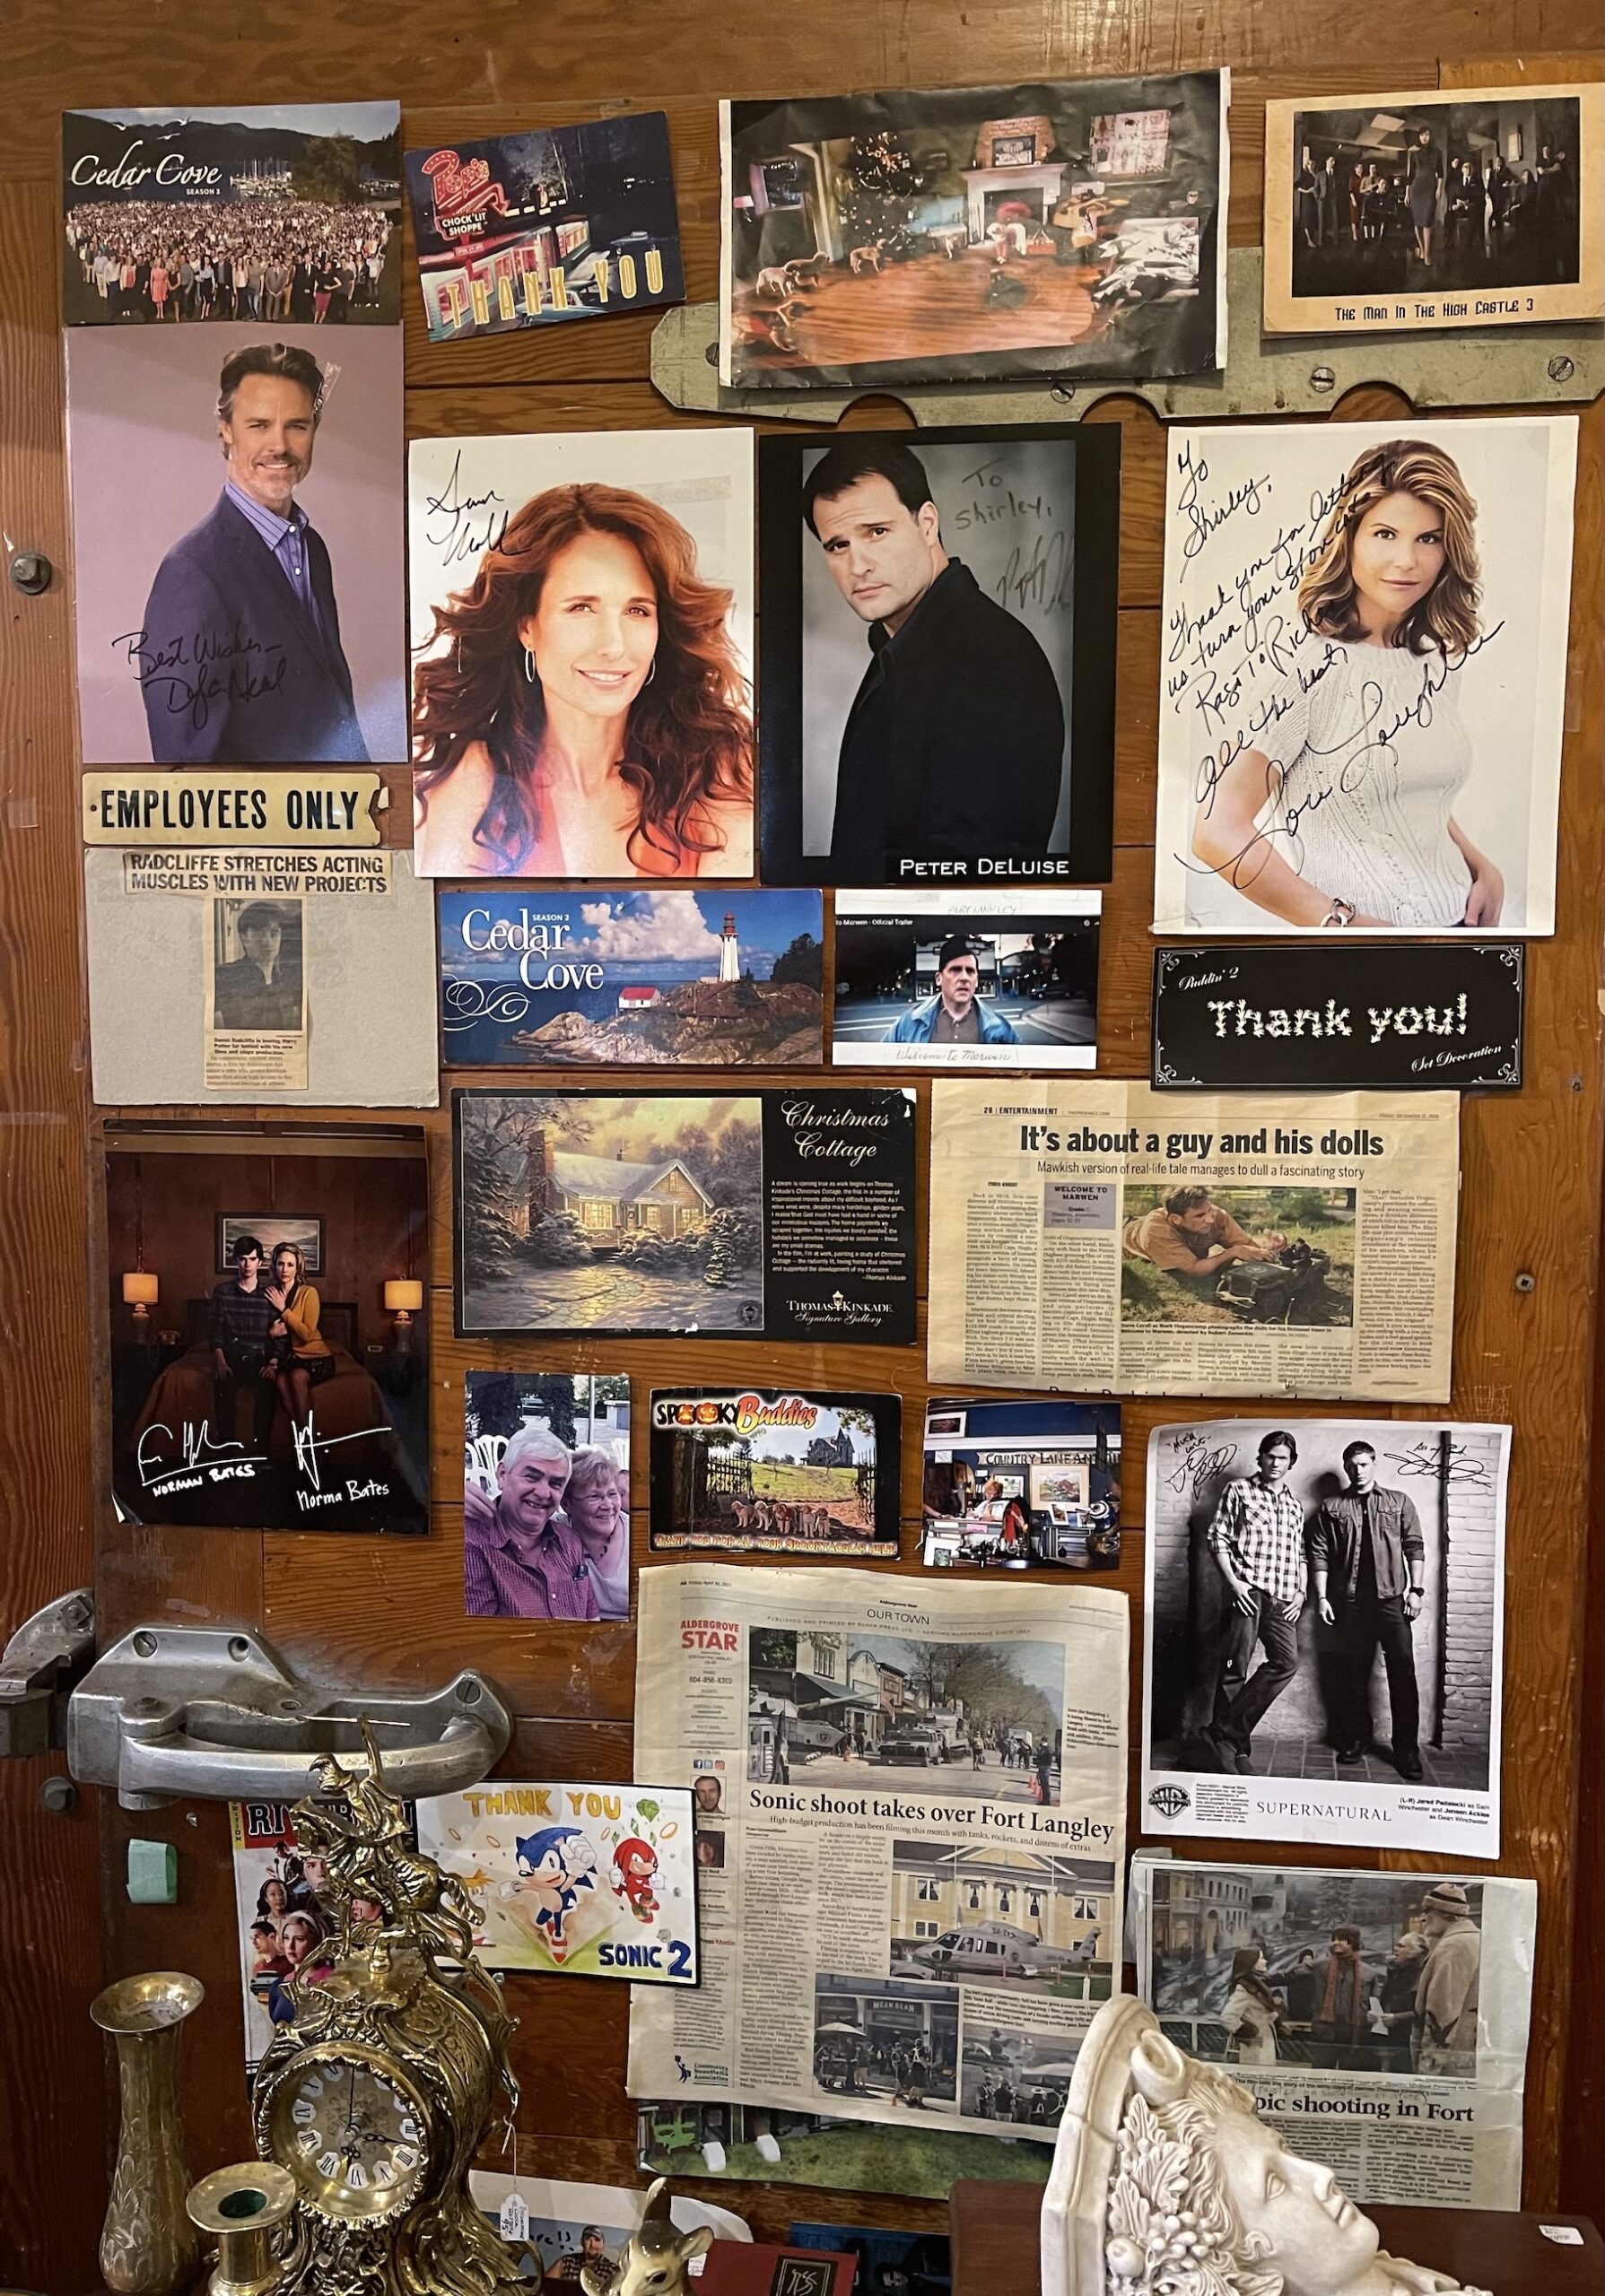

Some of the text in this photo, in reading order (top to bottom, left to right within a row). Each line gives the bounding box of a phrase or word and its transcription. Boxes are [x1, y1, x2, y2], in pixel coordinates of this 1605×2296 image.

[71, 140, 222, 188] Cedar Cove
[449, 222, 483, 236] SHOPPE
[446, 249, 664, 328] THANK YOU
[1526, 298, 1533, 311] 3
[962, 457, 1005, 487] To
[111, 631, 188, 680] Best
[1168, 672, 1189, 698] us
[1192, 624, 1242, 667] turn
[1250, 694, 1294, 735] the
[100, 789, 359, 830] EMPLOYEES ONLY
[131, 854, 383, 874] RADCLIFFE STRETCHES ACTING
[132, 874, 388, 893] MUSCLES WITH NEW PROJECTS
[462, 908, 570, 951] Cedar
[519, 949, 604, 990] Cove
[1228, 966, 1240, 979] 2
[1207, 992, 1468, 1044] Thank you!
[1411, 1044, 1503, 1073] Set Decoration
[781, 1100, 891, 1129] Christmas
[999, 1107, 1058, 1116] ENTERTAINMENT
[794, 1131, 878, 1167] Cottage
[1021, 1125, 1384, 1160] It's about a guy and his dolls
[1037, 1161, 1365, 1180] Mawkish version of real-life tale manages to dull a fascinating story
[786, 1300, 894, 1312] THOMAS KINKADE
[794, 1312, 883, 1326] Signature Gallery
[657, 1396, 819, 1435] SPOOKY Buddies
[987, 1452, 1035, 1465] COUNTRY
[1040, 1452, 1073, 1464] LANE
[153, 1464, 256, 1498] NORMAN BATES
[296, 1480, 389, 1512] Norma Bates
[655, 1535, 687, 1547] THANK
[786, 1538, 867, 1553] SPOOKTACULAR
[681, 1620, 739, 1632] ALDERGROVE
[867, 1609, 930, 1626] OUR TOWN
[682, 1631, 738, 1651] STAR
[463, 1789, 621, 1821] THANK YOU
[750, 1789, 1114, 1843] Sonic shoot takes over Fort Langley
[1256, 1800, 1392, 1822] SUPERNATURAL
[770, 1815, 814, 1827] High-budget
[814, 1821, 852, 1830] production
[868, 1822, 884, 1831] been
[885, 1824, 912, 1834] filming
[912, 1826, 926, 1834] this
[927, 1827, 950, 1837] month
[952, 1829, 967, 1838] with
[969, 1830, 990, 1840] tanks,
[991, 1833, 1018, 1844] rockets,
[1020, 1837, 1034, 1845] and
[1034, 1839, 1060, 1848] dozens
[1060, 1841, 1069, 1849] of
[1069, 1842, 1091, 1852] extras
[598, 1940, 693, 1979] SONIC 2
[1292, 2095, 1390, 2119] shooting
[1398, 2100, 1419, 2117] in
[1426, 2103, 1474, 2122] Fort
